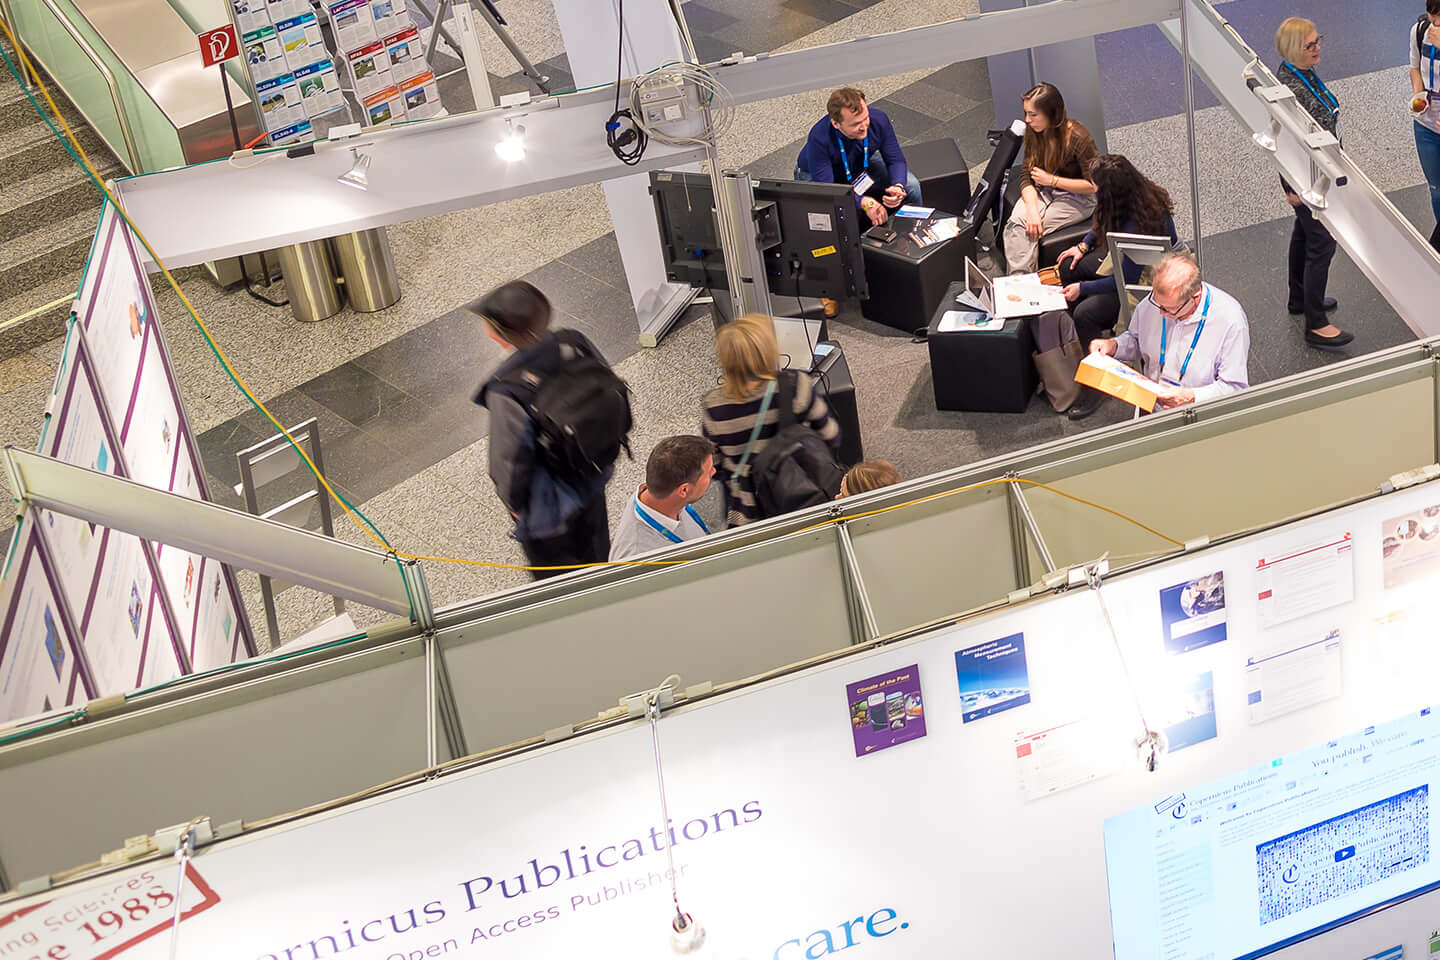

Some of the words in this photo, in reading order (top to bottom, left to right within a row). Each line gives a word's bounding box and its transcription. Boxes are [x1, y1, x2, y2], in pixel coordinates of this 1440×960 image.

[856, 682, 878, 695] Climate
[879, 679, 886, 688] of
[886, 676, 896, 686] the
[896, 673, 911, 683] Past
[458, 799, 764, 914] Publications
[43, 870, 157, 926] Sciences
[77, 885, 175, 945] 1988
[469, 903, 561, 945] Access
[570, 860, 690, 912] Publisher
[773, 904, 910, 960] care.
